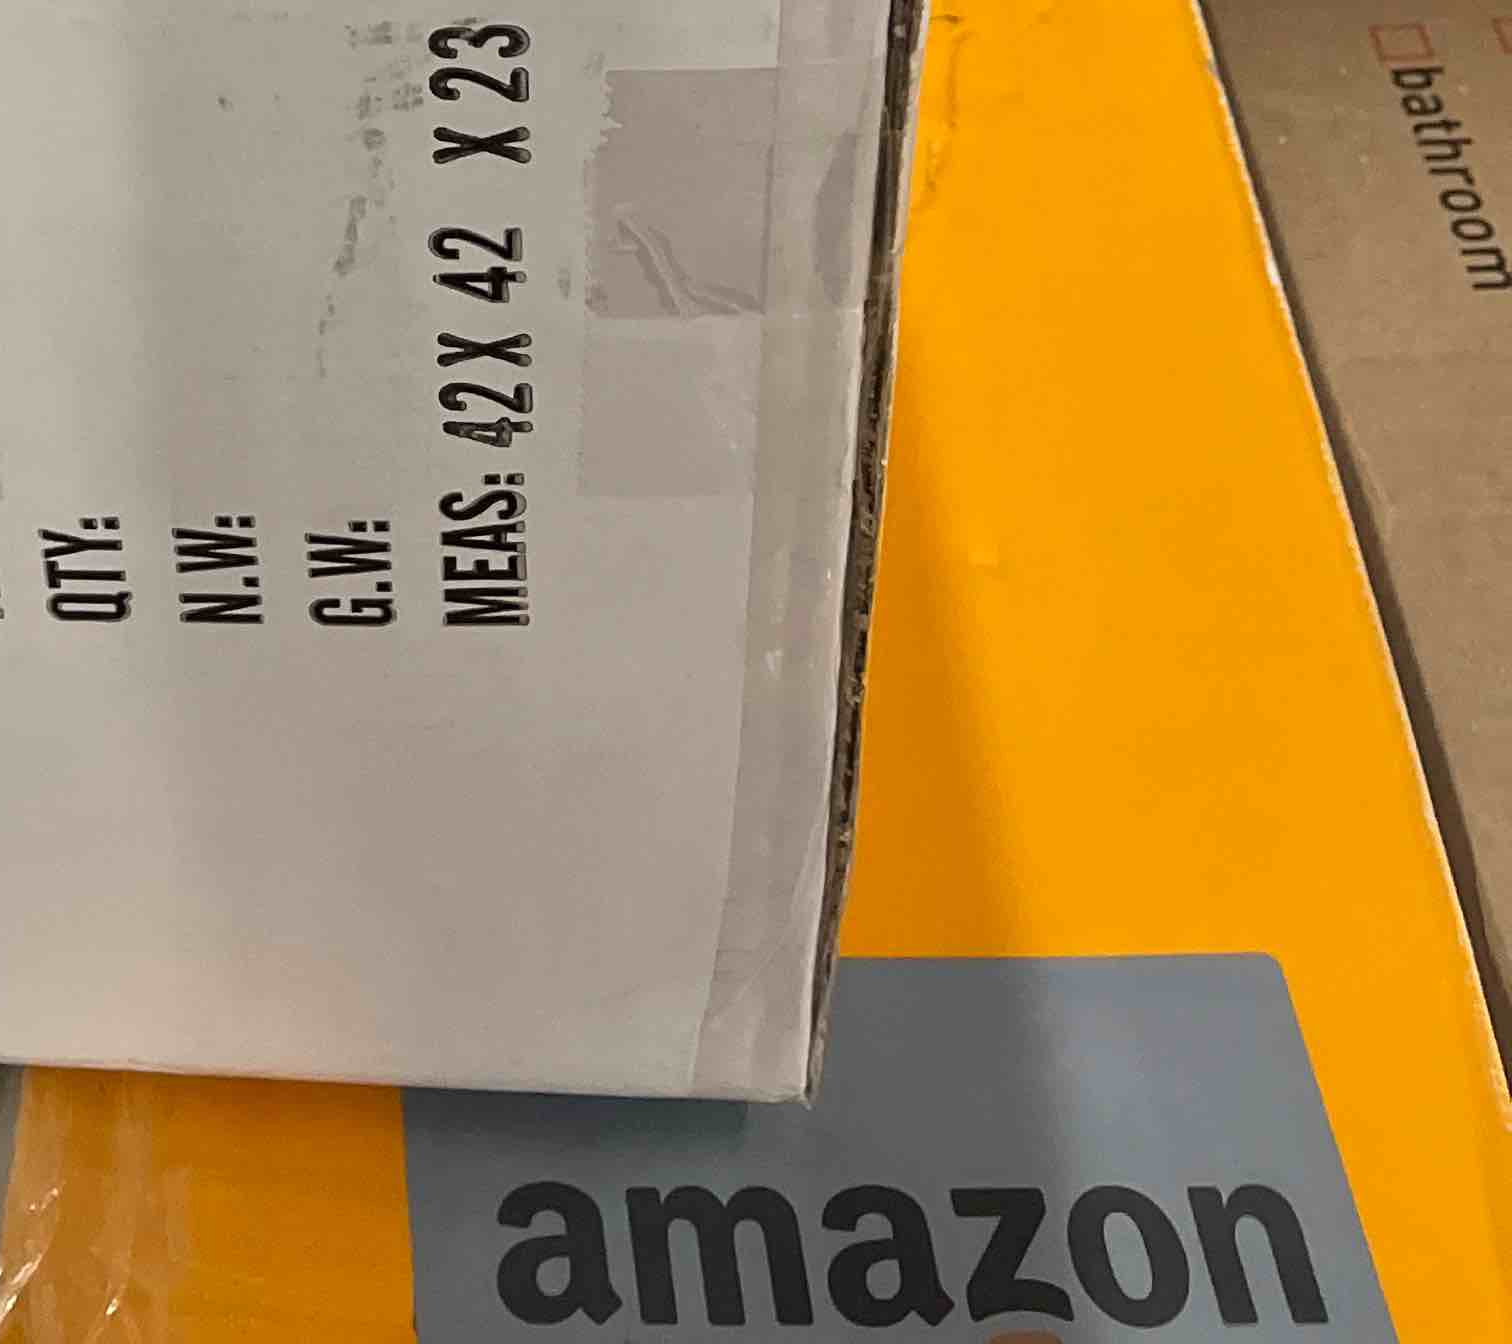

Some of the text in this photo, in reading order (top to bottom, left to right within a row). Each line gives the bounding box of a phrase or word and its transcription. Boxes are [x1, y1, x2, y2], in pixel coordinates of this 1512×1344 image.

[427, 22, 531, 103] 23
[1391, 64, 1512, 293] bathroom
[428, 225, 528, 303] 42
[437, 381, 533, 448] 42
[39, 515, 133, 623] QTY:
[172, 515, 265, 625] N.W:
[305, 519, 398, 628] G.W:
[437, 472, 531, 627] MEAS:
[496, 1179, 1330, 1328] amazon
